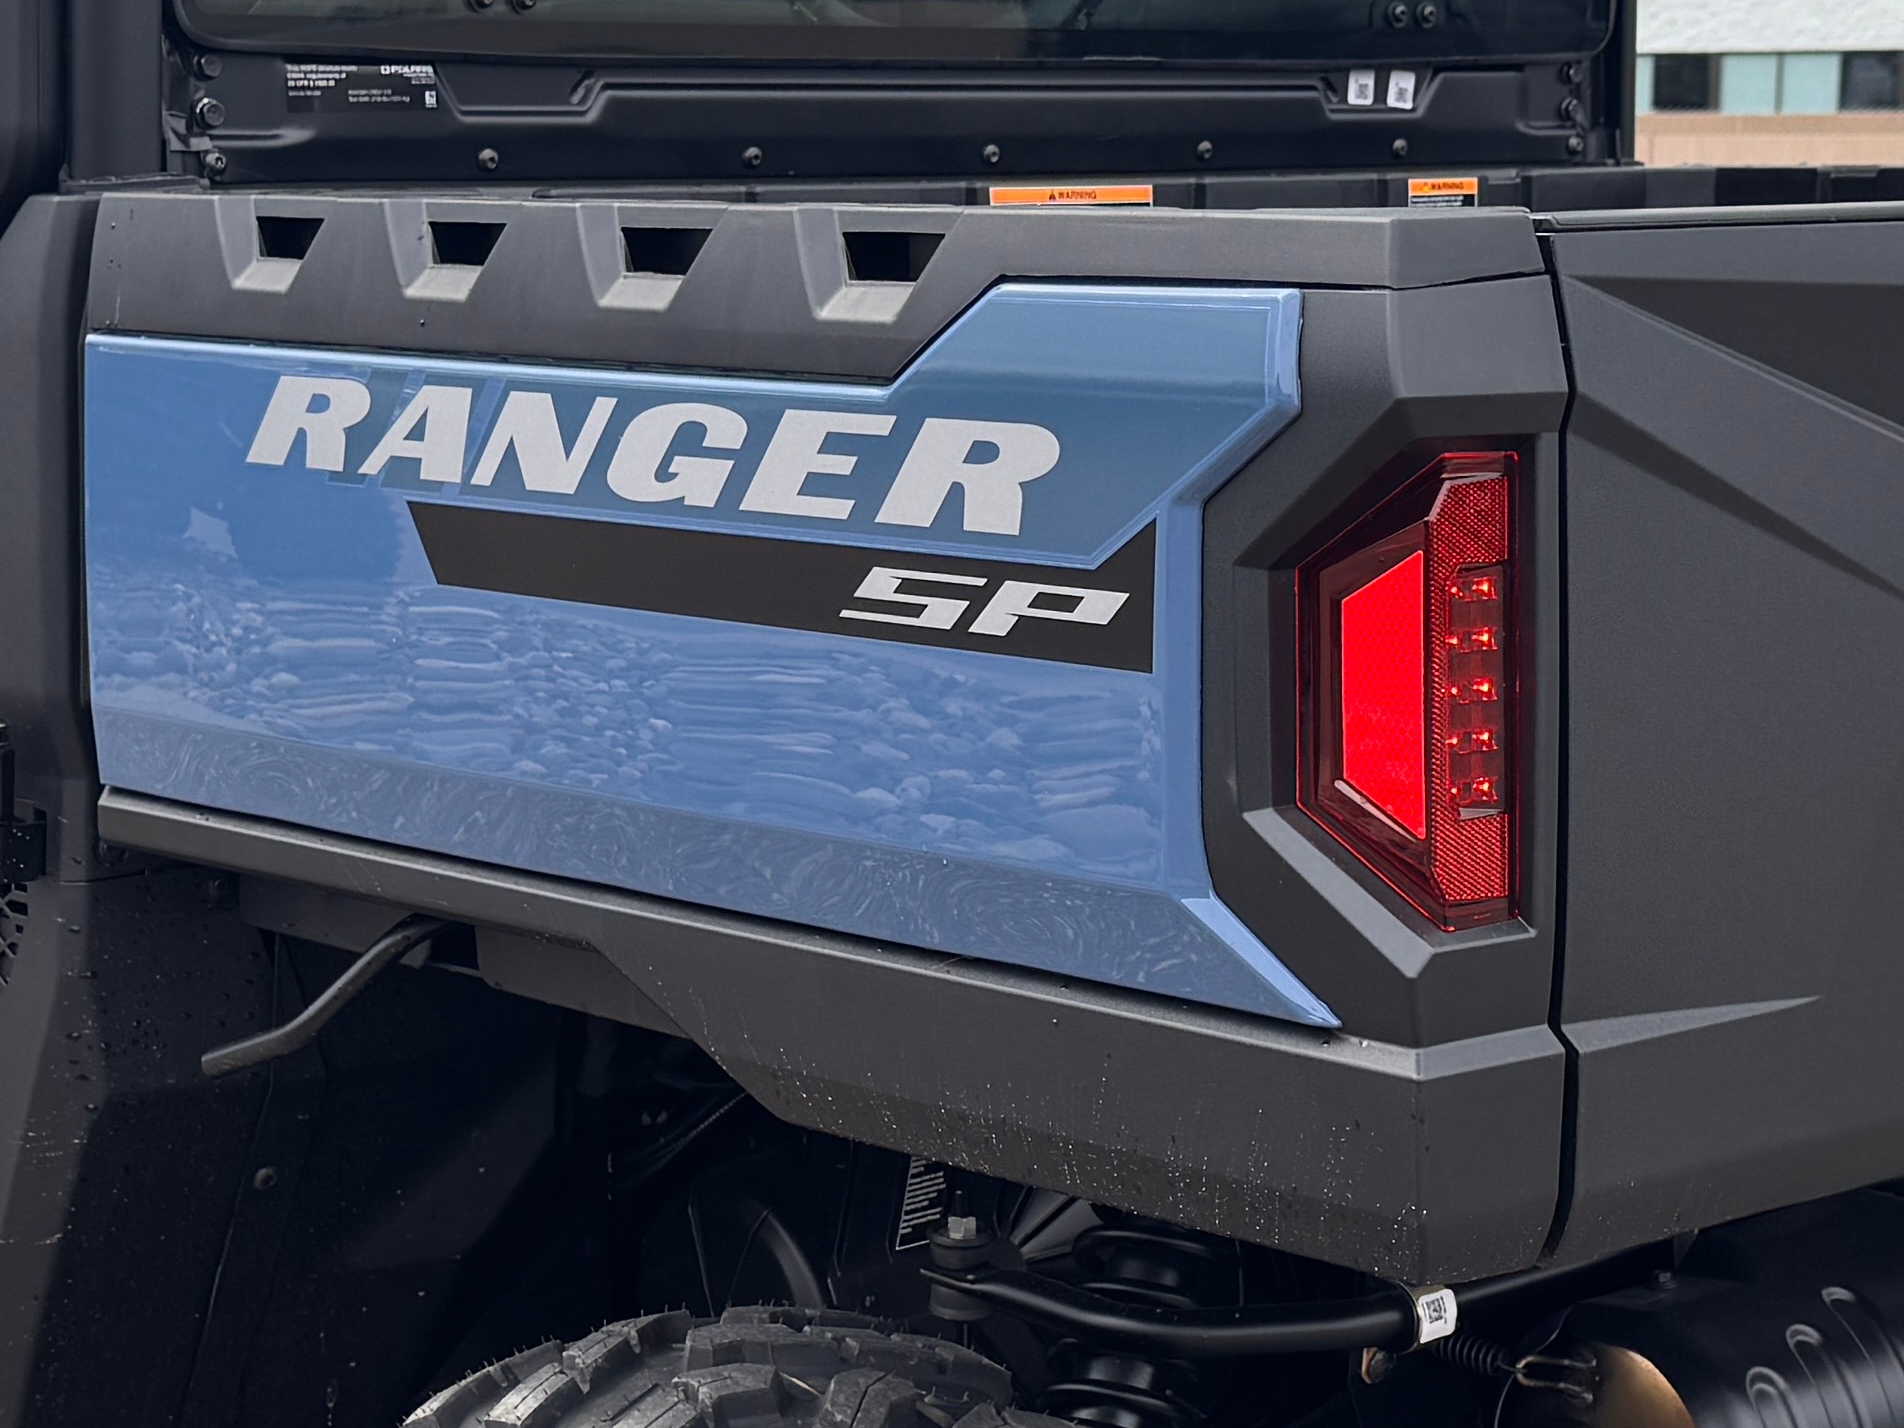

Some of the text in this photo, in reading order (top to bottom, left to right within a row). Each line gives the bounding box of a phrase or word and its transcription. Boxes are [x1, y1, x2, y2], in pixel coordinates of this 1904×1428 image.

[1058, 189, 1097, 200] WARNING
[246, 372, 1061, 537] RANGER
[839, 565, 1130, 637] SP
